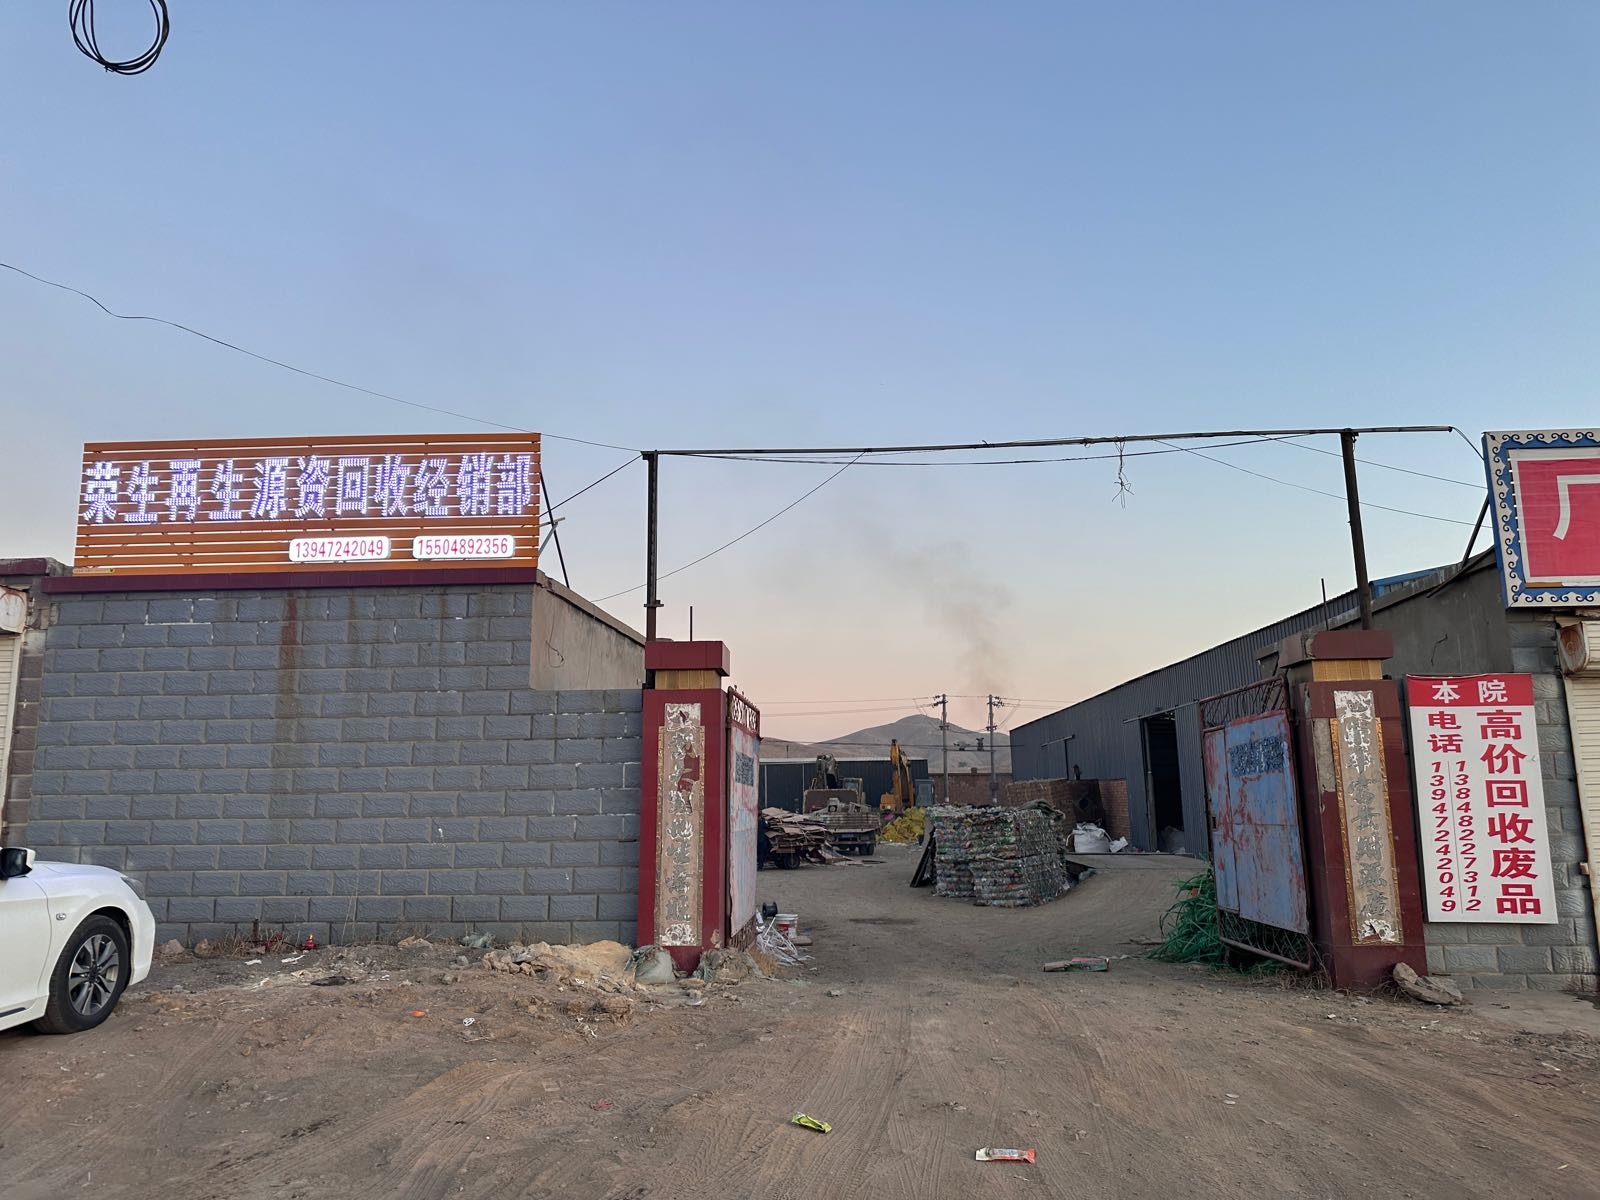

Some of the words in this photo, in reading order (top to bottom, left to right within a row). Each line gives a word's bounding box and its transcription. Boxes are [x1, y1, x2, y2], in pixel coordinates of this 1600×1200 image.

[83, 452, 531, 523] 荣生再生源资回收经销部
[295, 539, 384, 559] 13947242049
[418, 537, 508, 556] 15504892356
[1431, 679, 1509, 704] 本院
[1427, 710, 1464, 754] 电话
[1429, 761, 1457, 912] 13947242049
[1454, 760, 1482, 912] 13848227312
[1476, 709, 1542, 915] 高价回收废品
